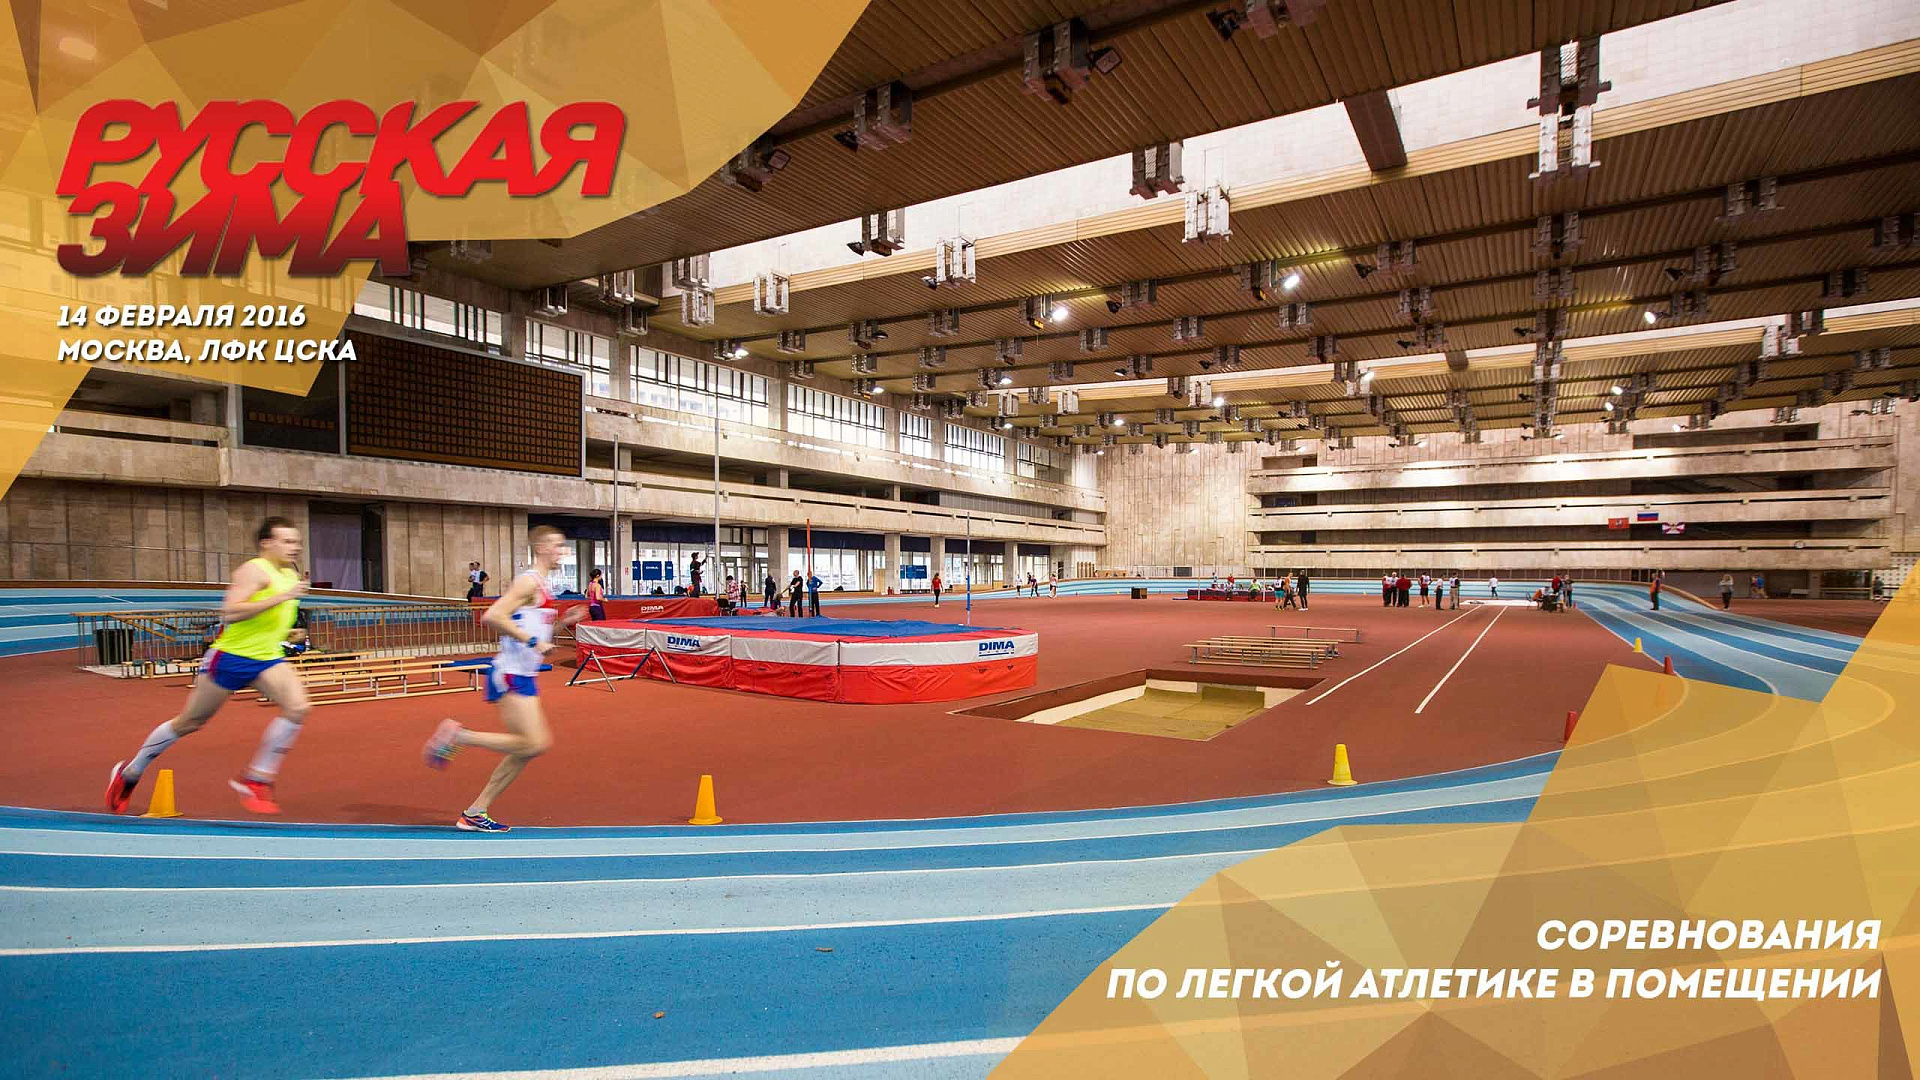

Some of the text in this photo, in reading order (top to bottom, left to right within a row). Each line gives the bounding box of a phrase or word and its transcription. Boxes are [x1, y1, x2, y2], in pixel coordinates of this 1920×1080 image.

[640, 605, 664, 613] DIMA
[667, 635, 701, 648] DIMA
[978, 640, 1015, 651] DIMA
